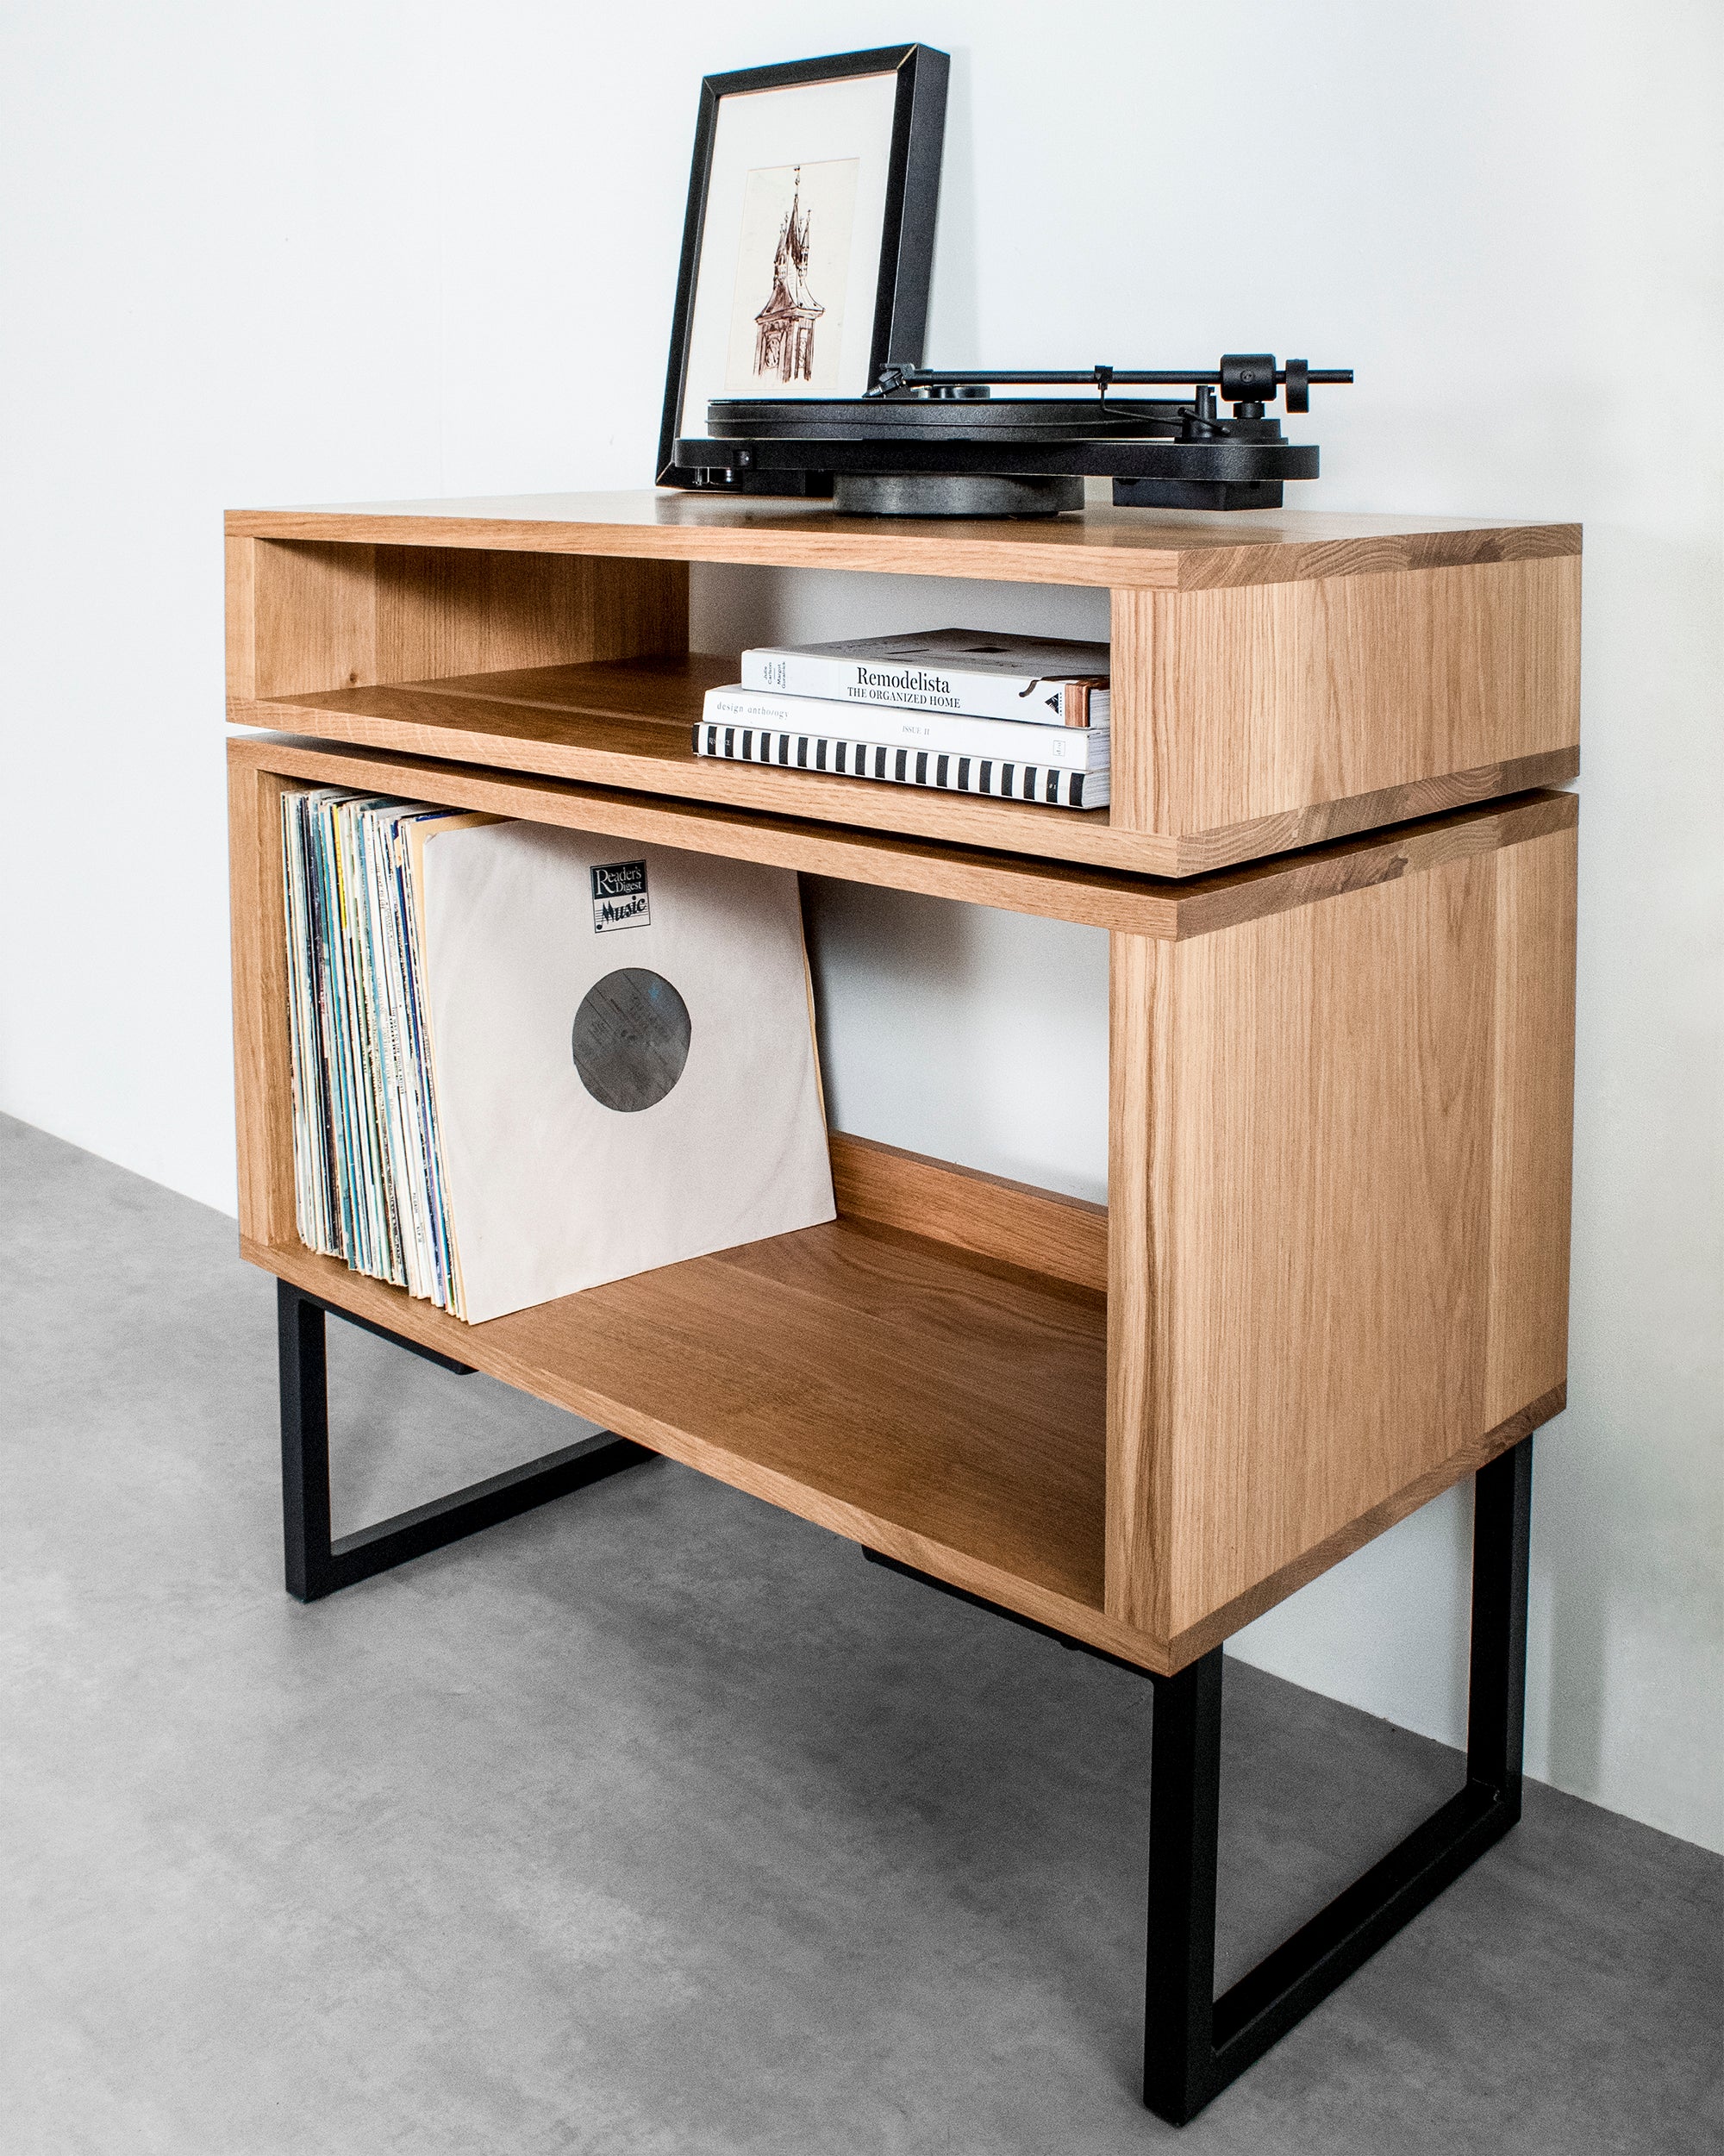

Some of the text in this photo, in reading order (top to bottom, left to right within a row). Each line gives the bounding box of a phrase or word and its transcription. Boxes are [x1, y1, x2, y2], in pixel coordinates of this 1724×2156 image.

[857, 666, 951, 693] Remodelista
[847, 686, 961, 708] THE ORGANIZED HOME
[716, 702, 789, 720] design anthology
[902, 725, 921, 734] ISSUE
[595, 866, 642, 895] Reader's
[615, 879, 642, 893] Digest
[600, 894, 646, 925] Music
